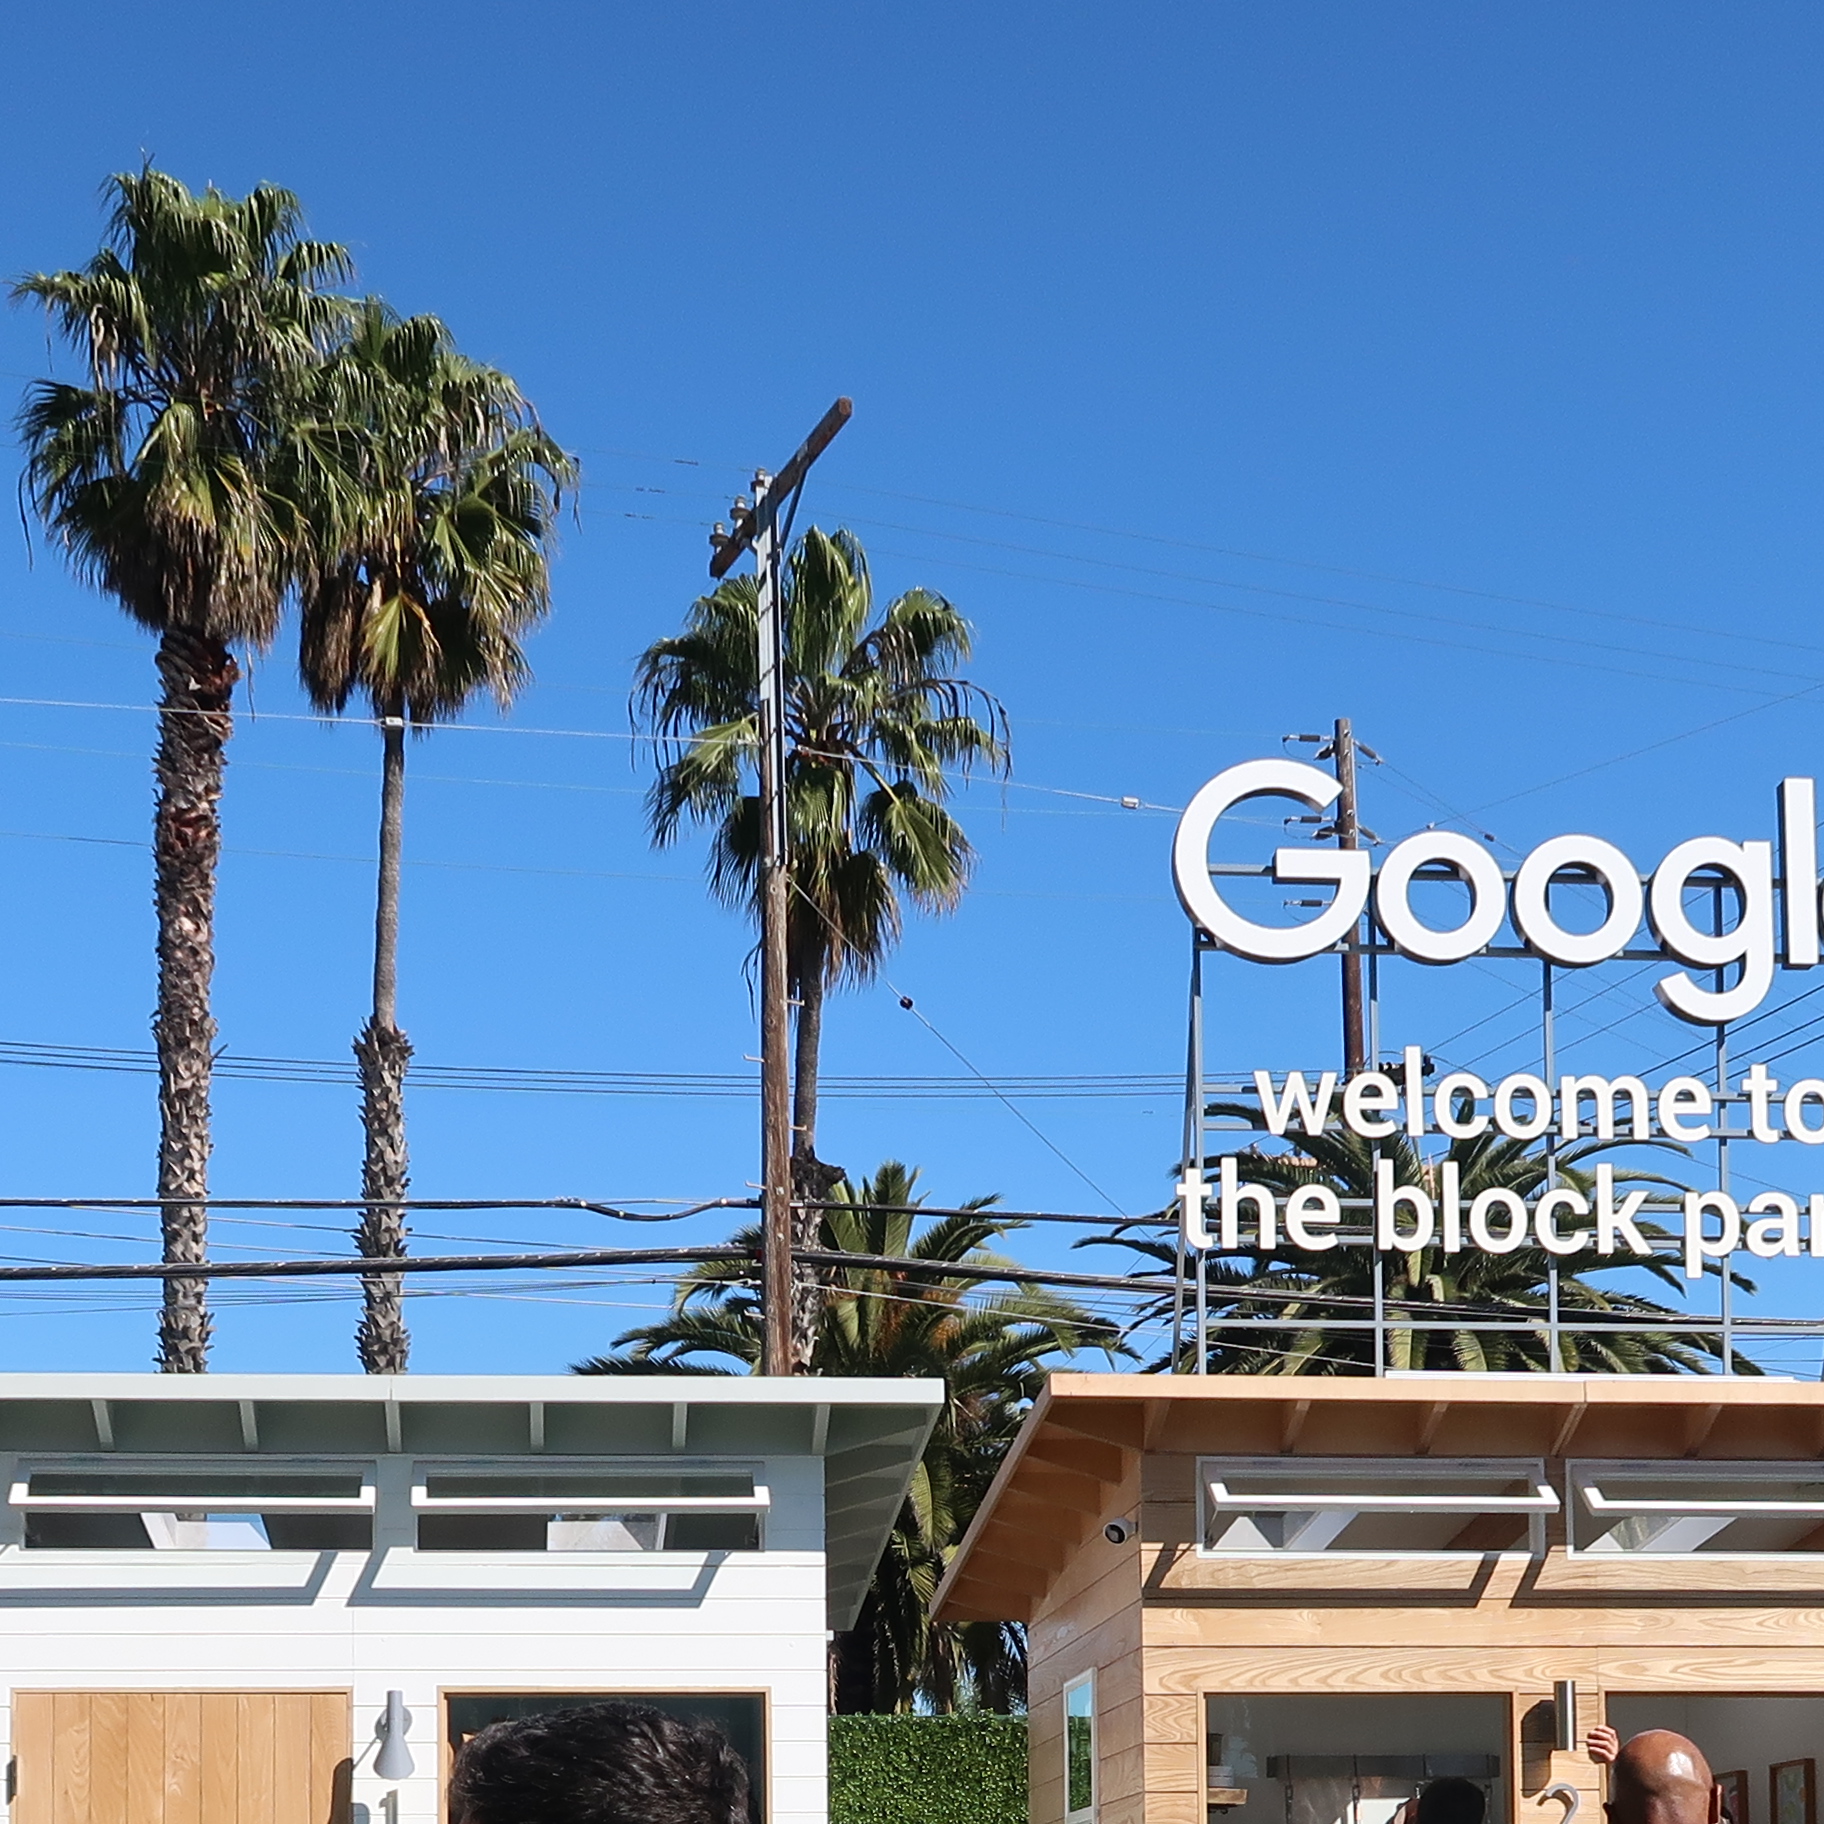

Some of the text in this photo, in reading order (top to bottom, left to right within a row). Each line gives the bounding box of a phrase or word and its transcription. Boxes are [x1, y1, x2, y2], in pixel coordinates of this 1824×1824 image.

[1253, 1045, 1713, 1144] welcome
[1177, 1158, 1343, 1252] the
[1377, 1160, 1655, 1256] block
